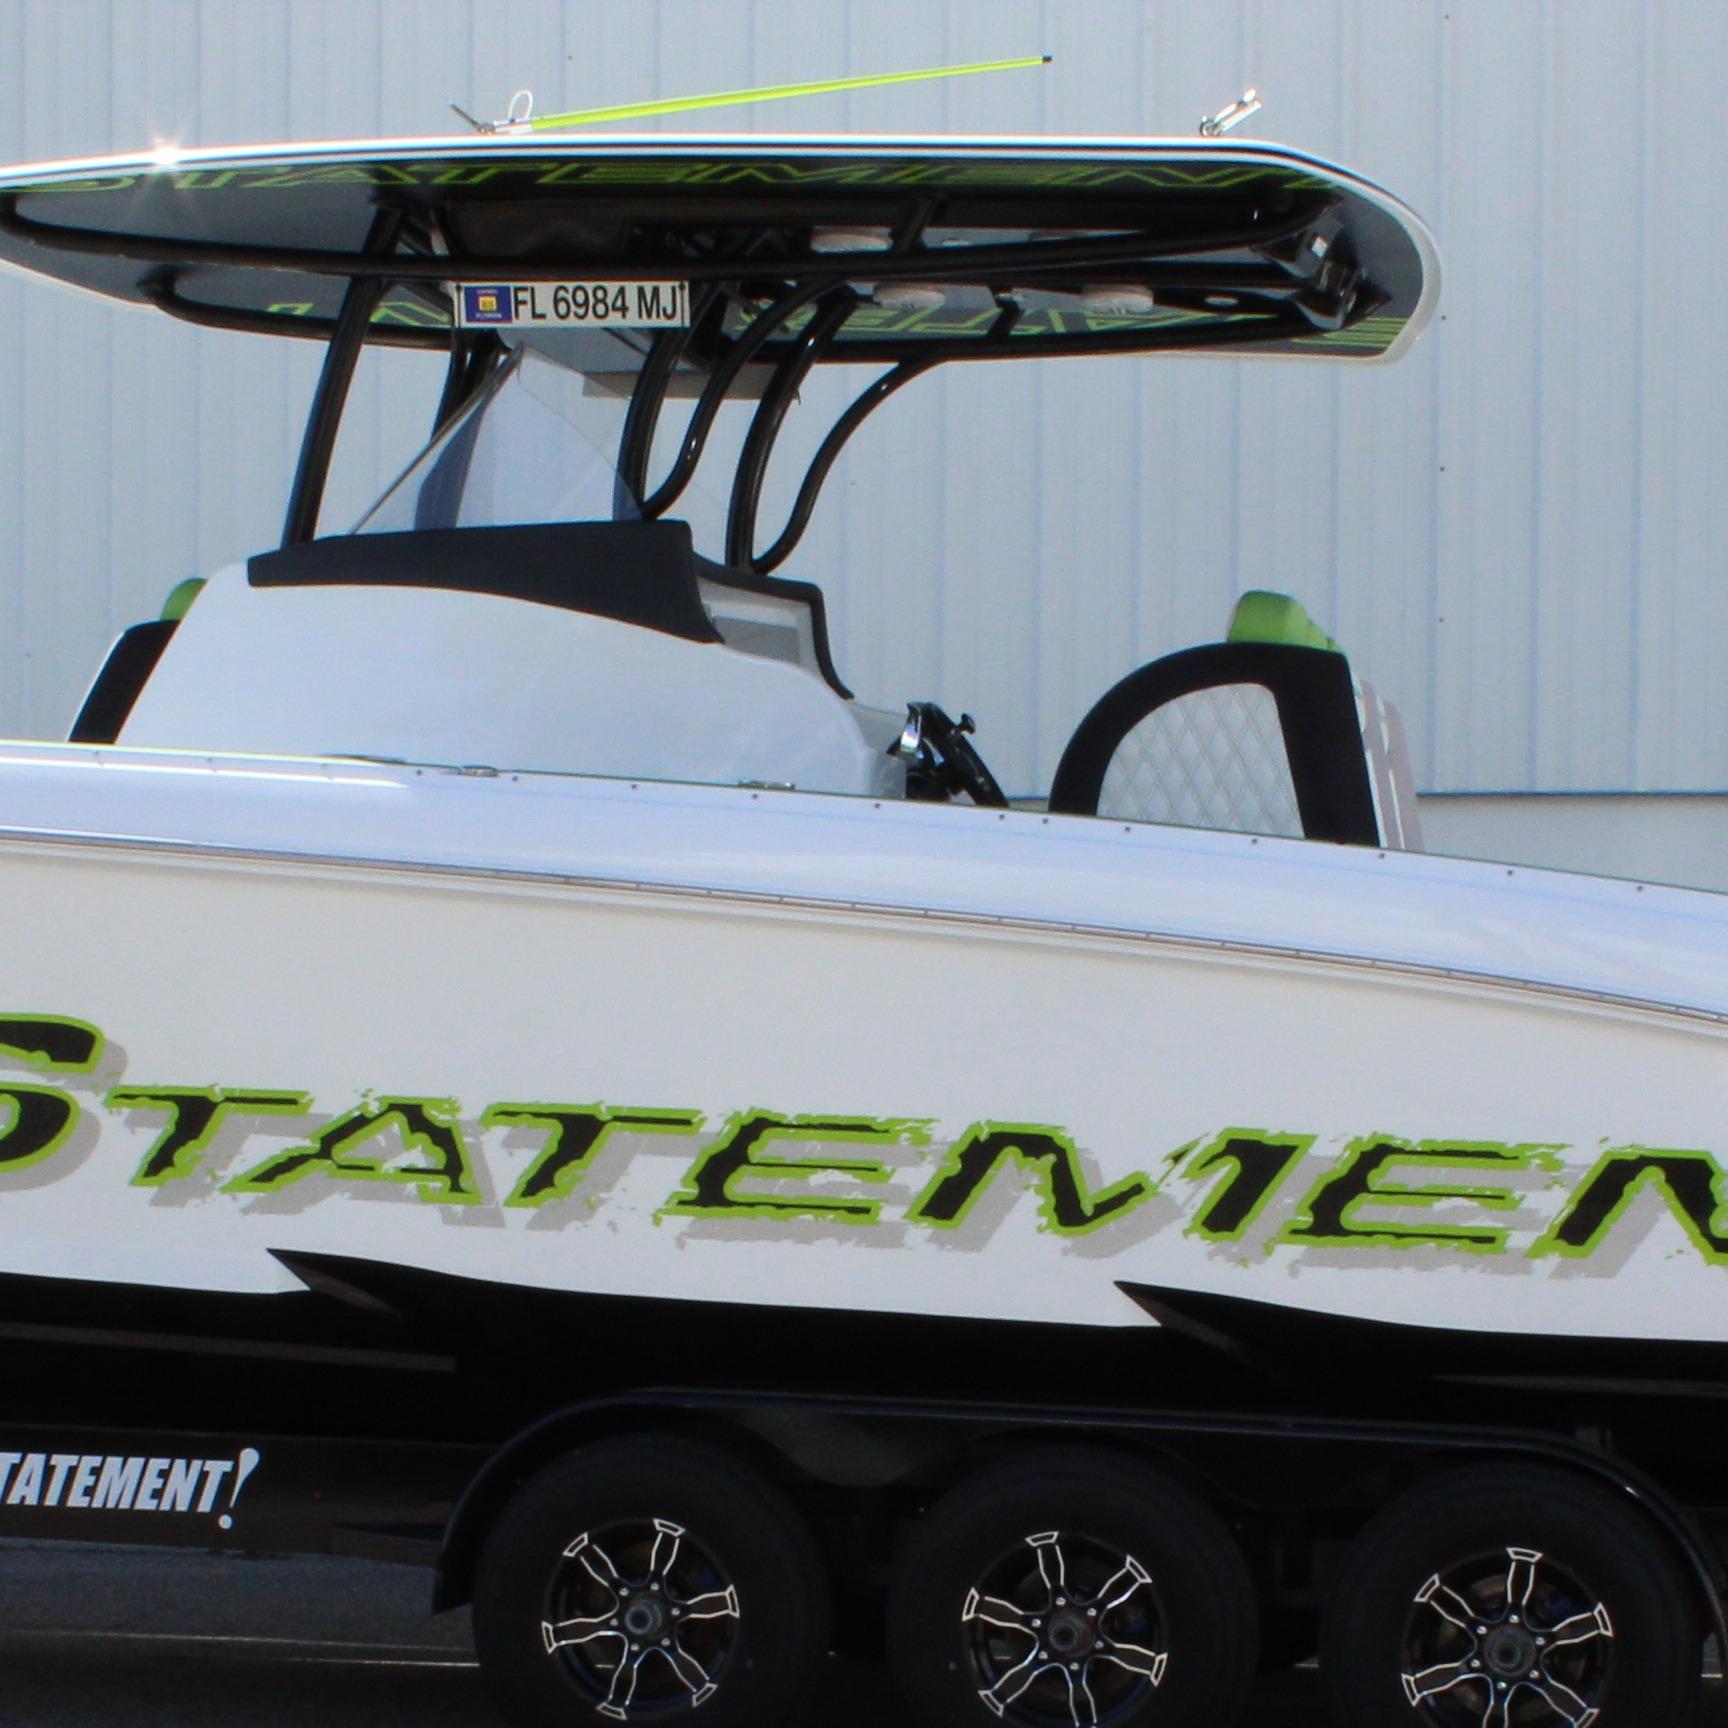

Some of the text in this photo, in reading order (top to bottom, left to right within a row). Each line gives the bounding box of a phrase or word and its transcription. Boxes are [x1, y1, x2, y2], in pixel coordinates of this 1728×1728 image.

[513, 284, 678, 320] FL 6984 MJ
